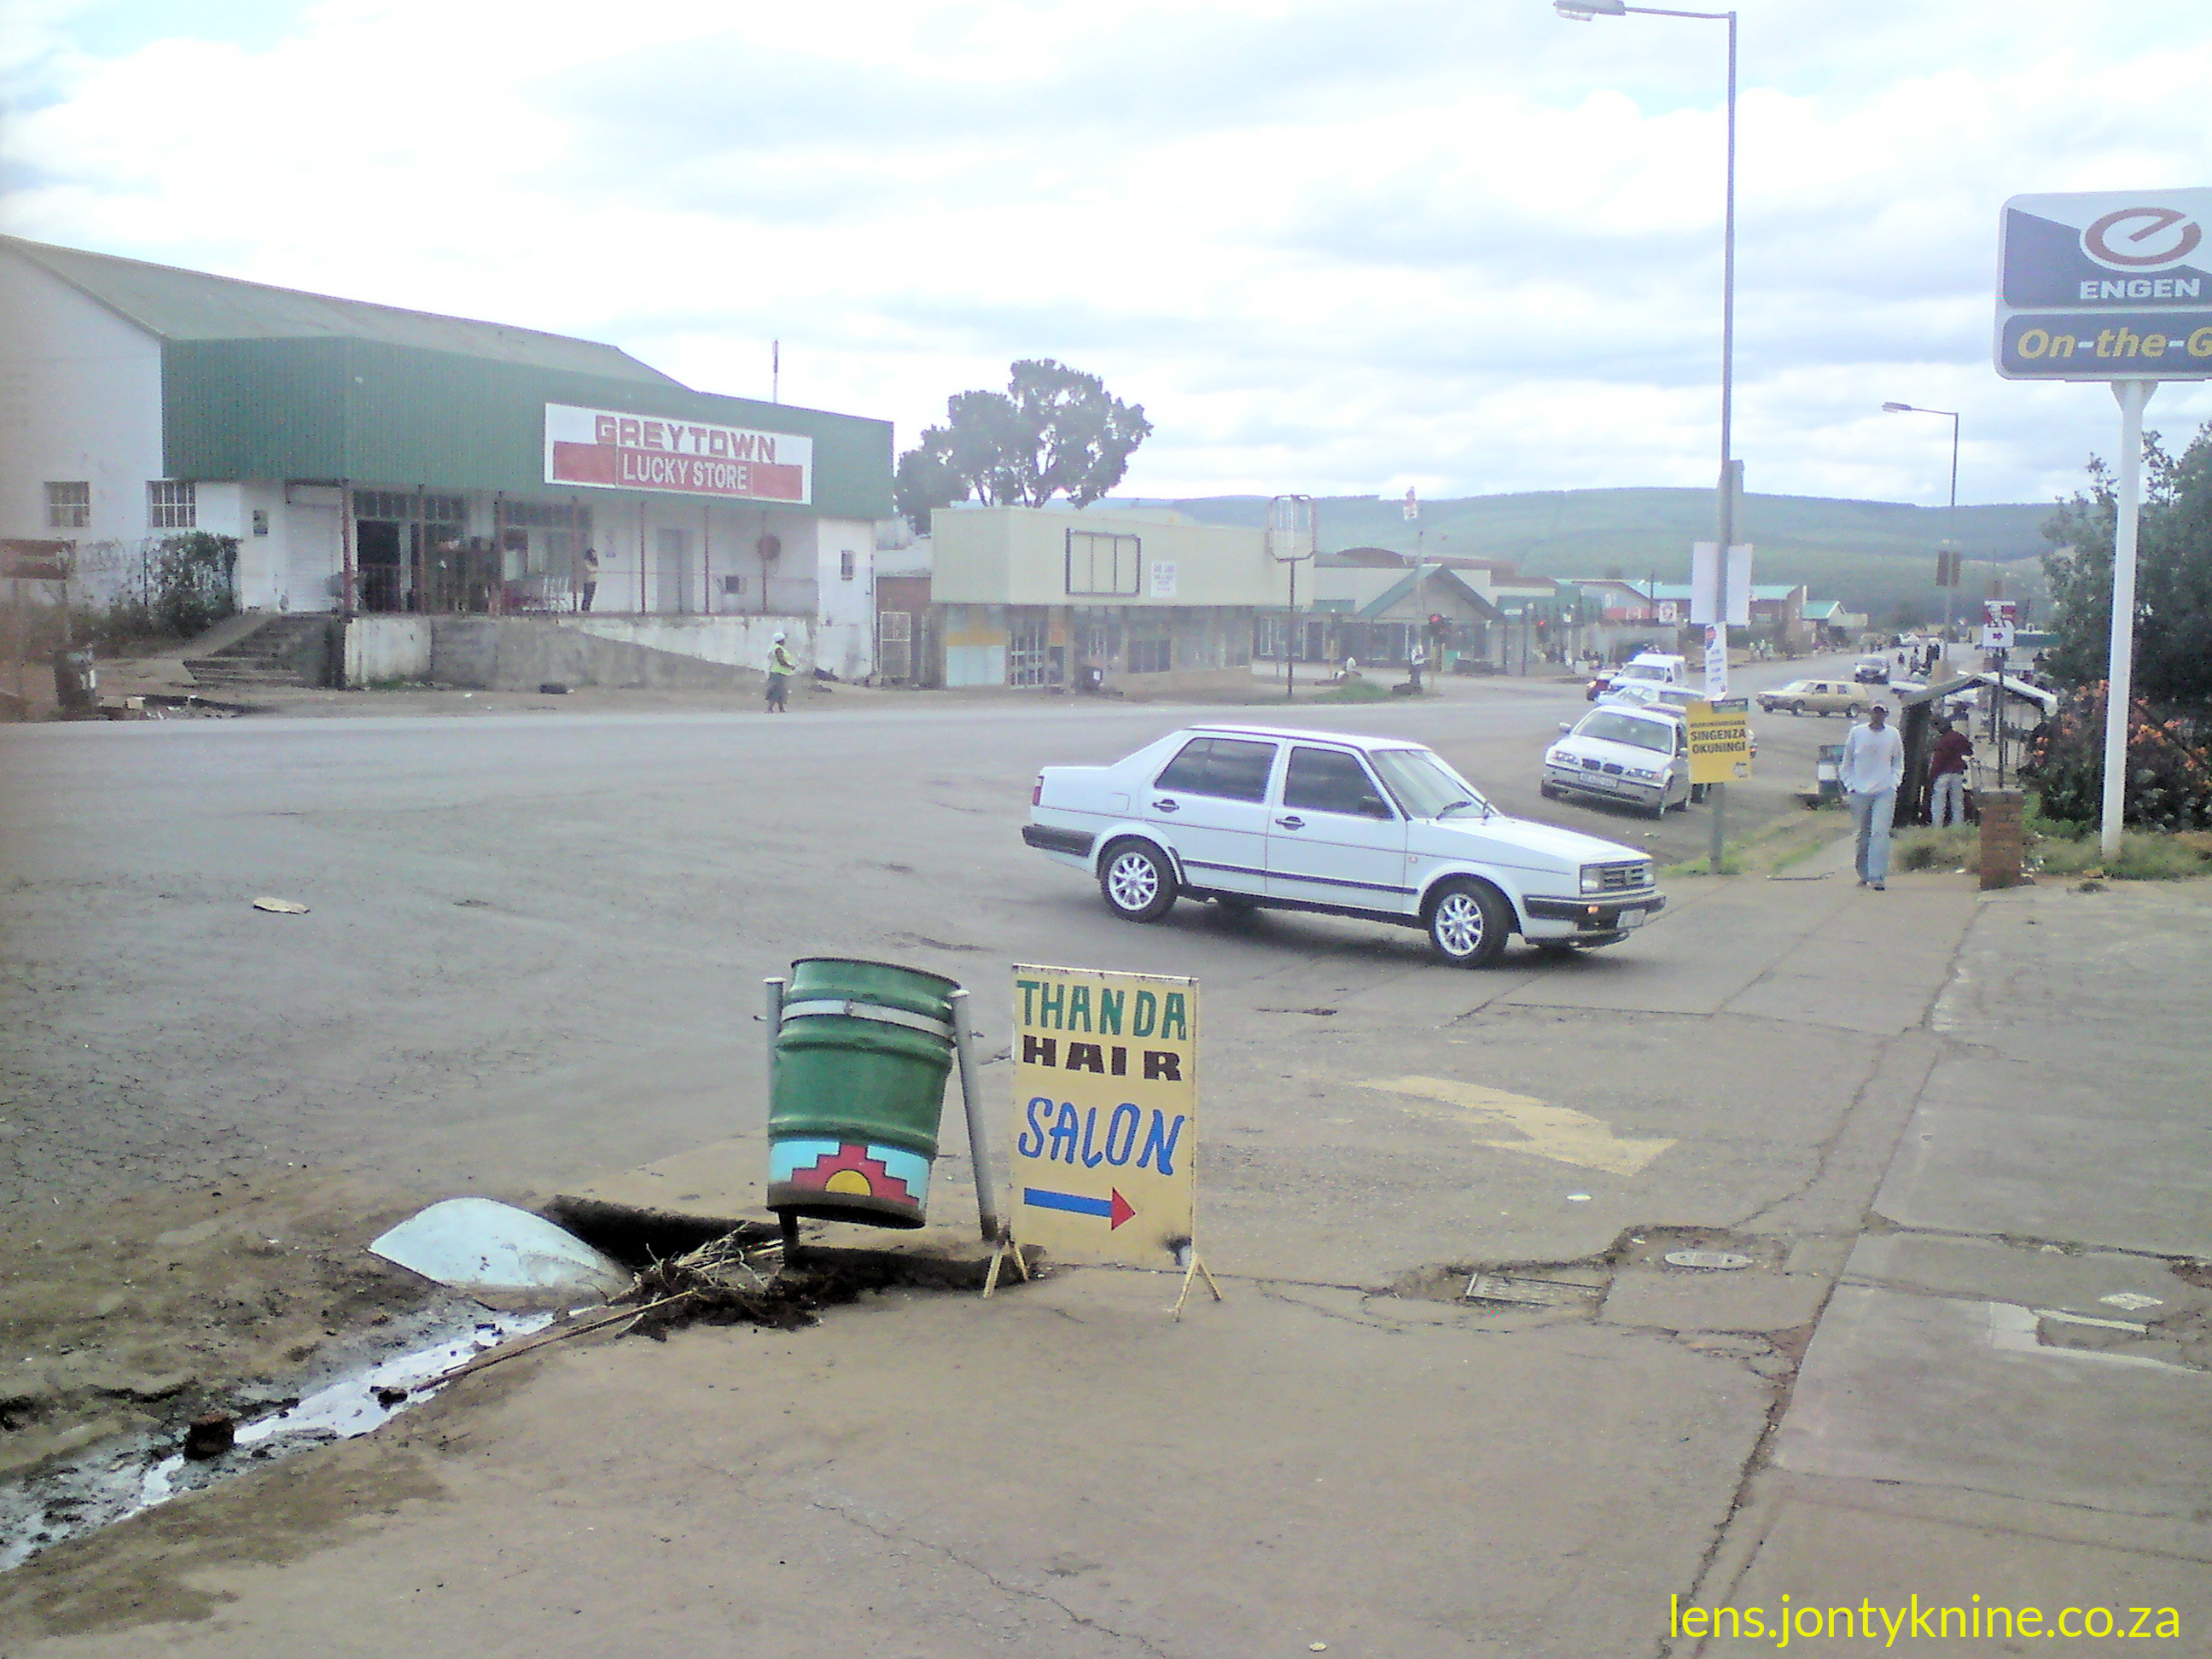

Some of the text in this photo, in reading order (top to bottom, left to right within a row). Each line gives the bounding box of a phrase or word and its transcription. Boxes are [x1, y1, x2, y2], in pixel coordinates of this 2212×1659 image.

[2080, 278, 2201, 300] ENGEN
[596, 415, 776, 463] GREYTOWN
[622, 453, 748, 490] LUCKY STORE
[1690, 728, 1746, 742] SINGENZA
[1016, 980, 1186, 1040] THANDA
[1022, 1034, 1182, 1081] HAIR
[1018, 1097, 1185, 1176] SALON
